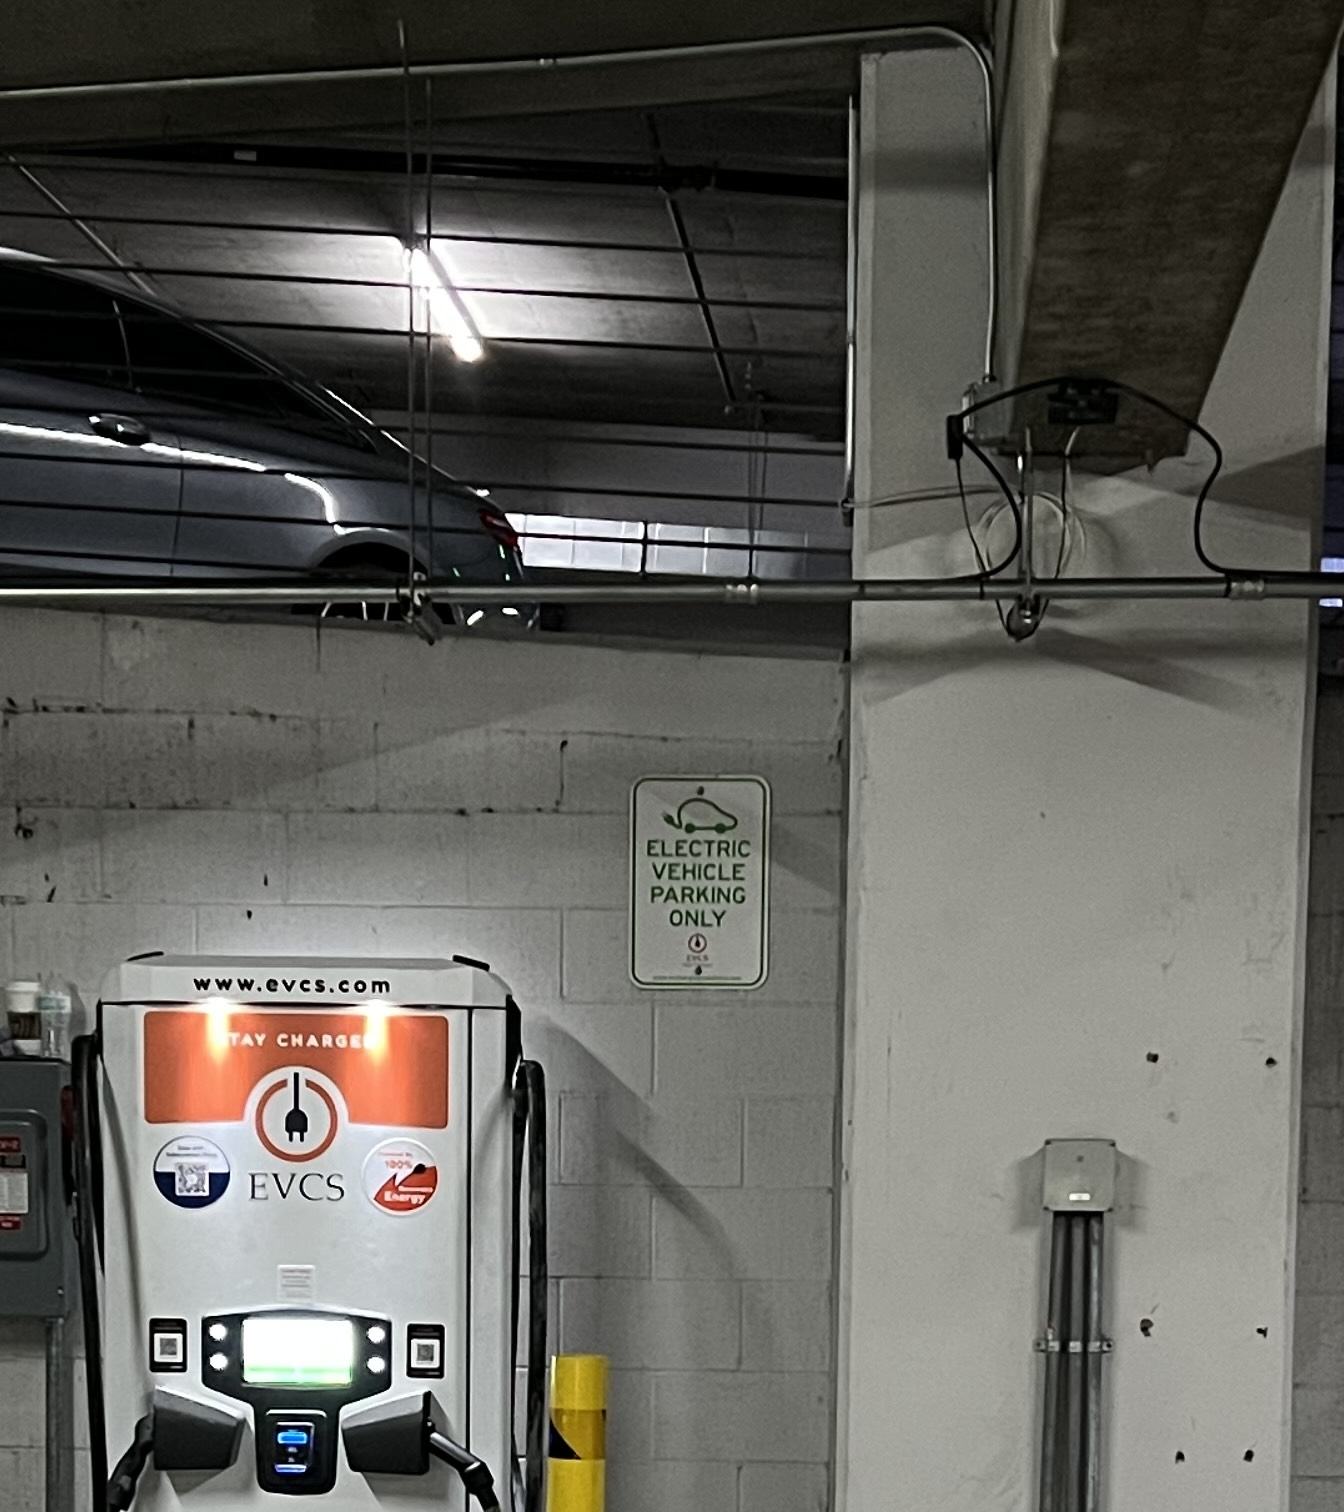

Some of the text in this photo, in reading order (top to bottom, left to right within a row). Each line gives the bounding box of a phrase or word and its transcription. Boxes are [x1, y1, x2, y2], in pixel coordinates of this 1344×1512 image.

[646, 839, 751, 858] ELECTRIC
[651, 862, 746, 881] VEHICLE
[650, 885, 746, 905] PARKING
[669, 909, 727, 928] ONLY
[193, 976, 391, 994] www.evcs.com
[217, 1032, 374, 1049] TAY CHARGE
[248, 1171, 345, 1202] EVCS
